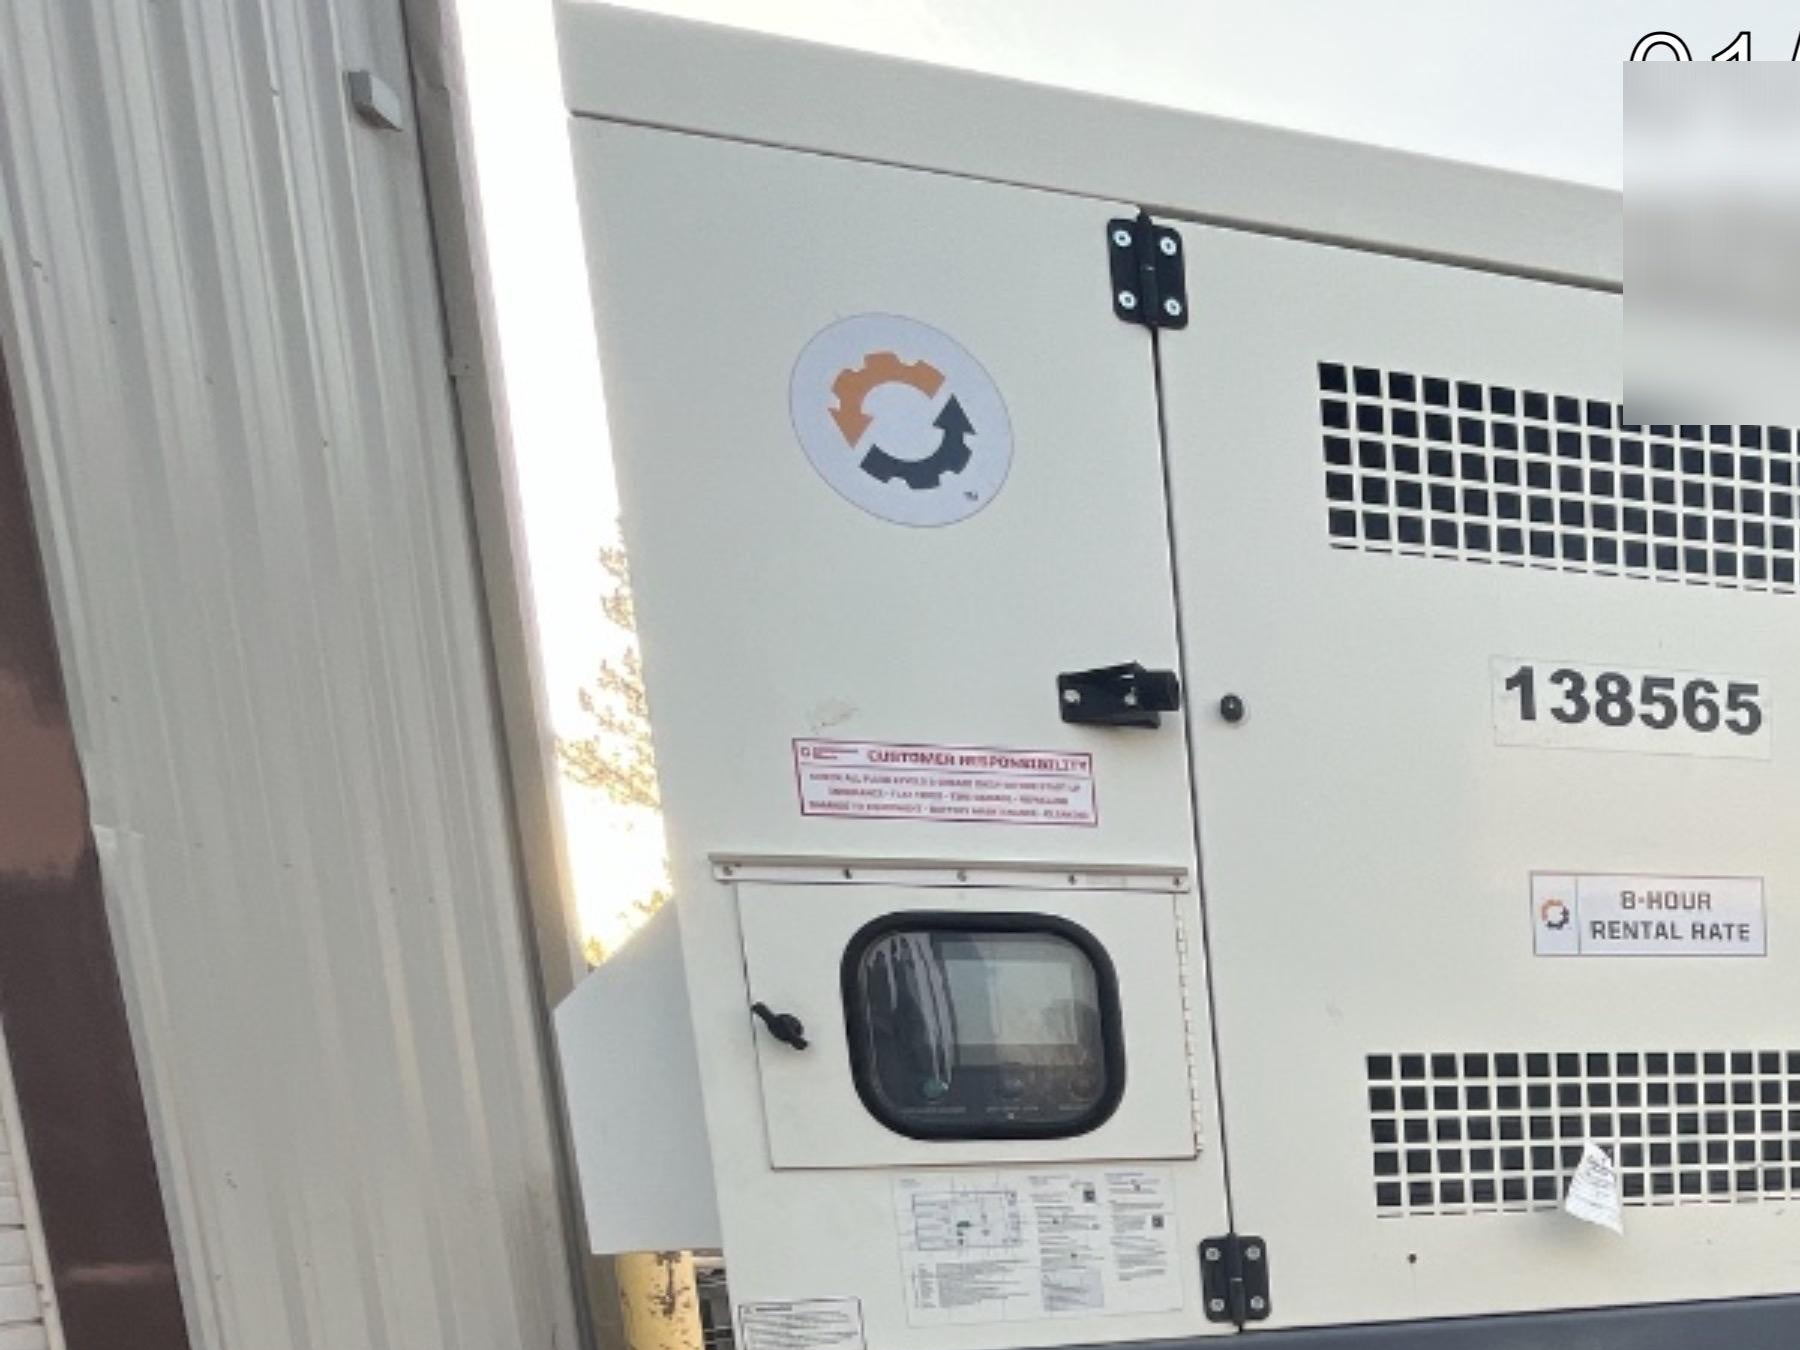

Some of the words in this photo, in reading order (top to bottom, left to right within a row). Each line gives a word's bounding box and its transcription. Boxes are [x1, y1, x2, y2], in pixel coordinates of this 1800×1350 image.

[1505, 665, 1763, 736] 138565
[1620, 890, 1711, 911] 8-HOUR
[1590, 920, 1684, 940] RENTAL
[1691, 922, 1750, 942] RATE
